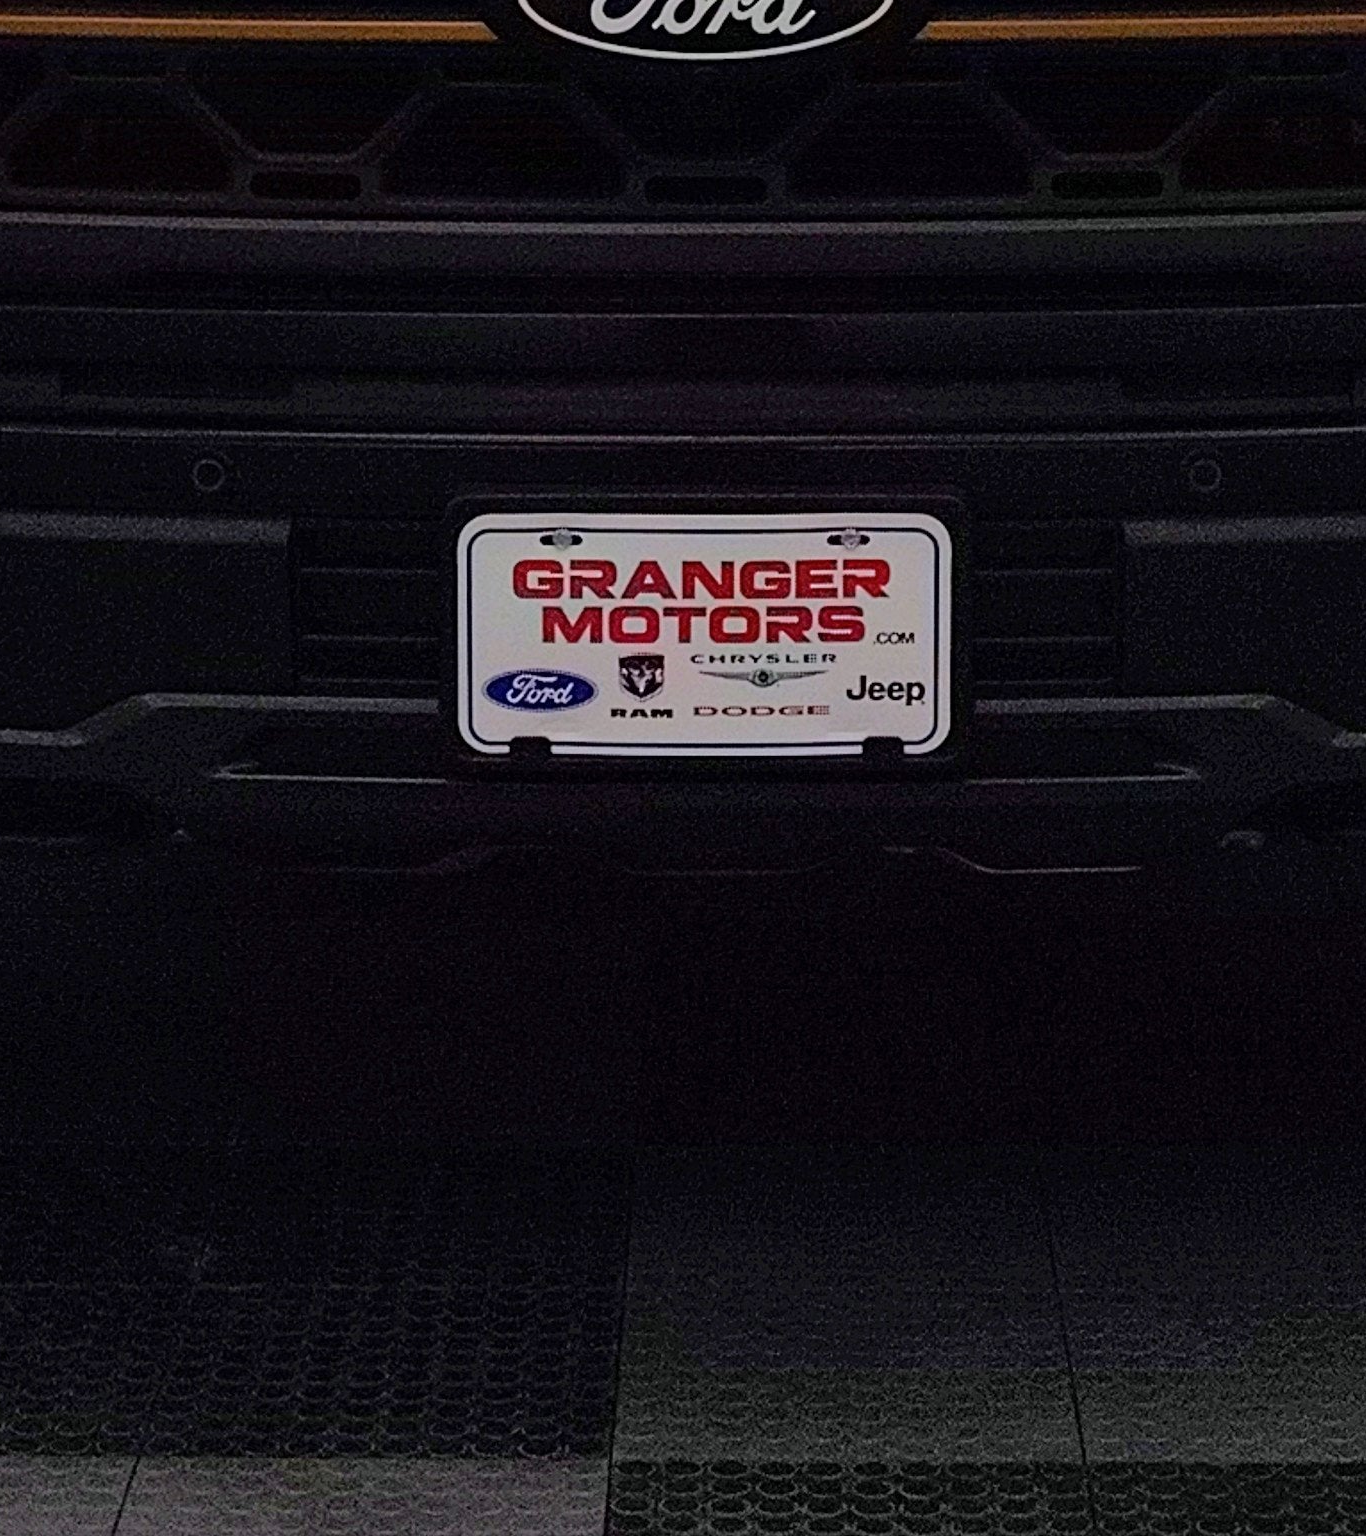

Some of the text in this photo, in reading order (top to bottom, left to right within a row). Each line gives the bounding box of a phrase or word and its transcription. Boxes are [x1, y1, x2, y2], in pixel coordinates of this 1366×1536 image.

[512, 558, 890, 599] GRANGER
[541, 605, 866, 644] MOTORS
[690, 654, 837, 664] CHRYSLER
[505, 673, 575, 704] Ford
[845, 675, 926, 707] Jeep
[610, 707, 674, 719] RAM
[693, 705, 831, 716] DODGE
